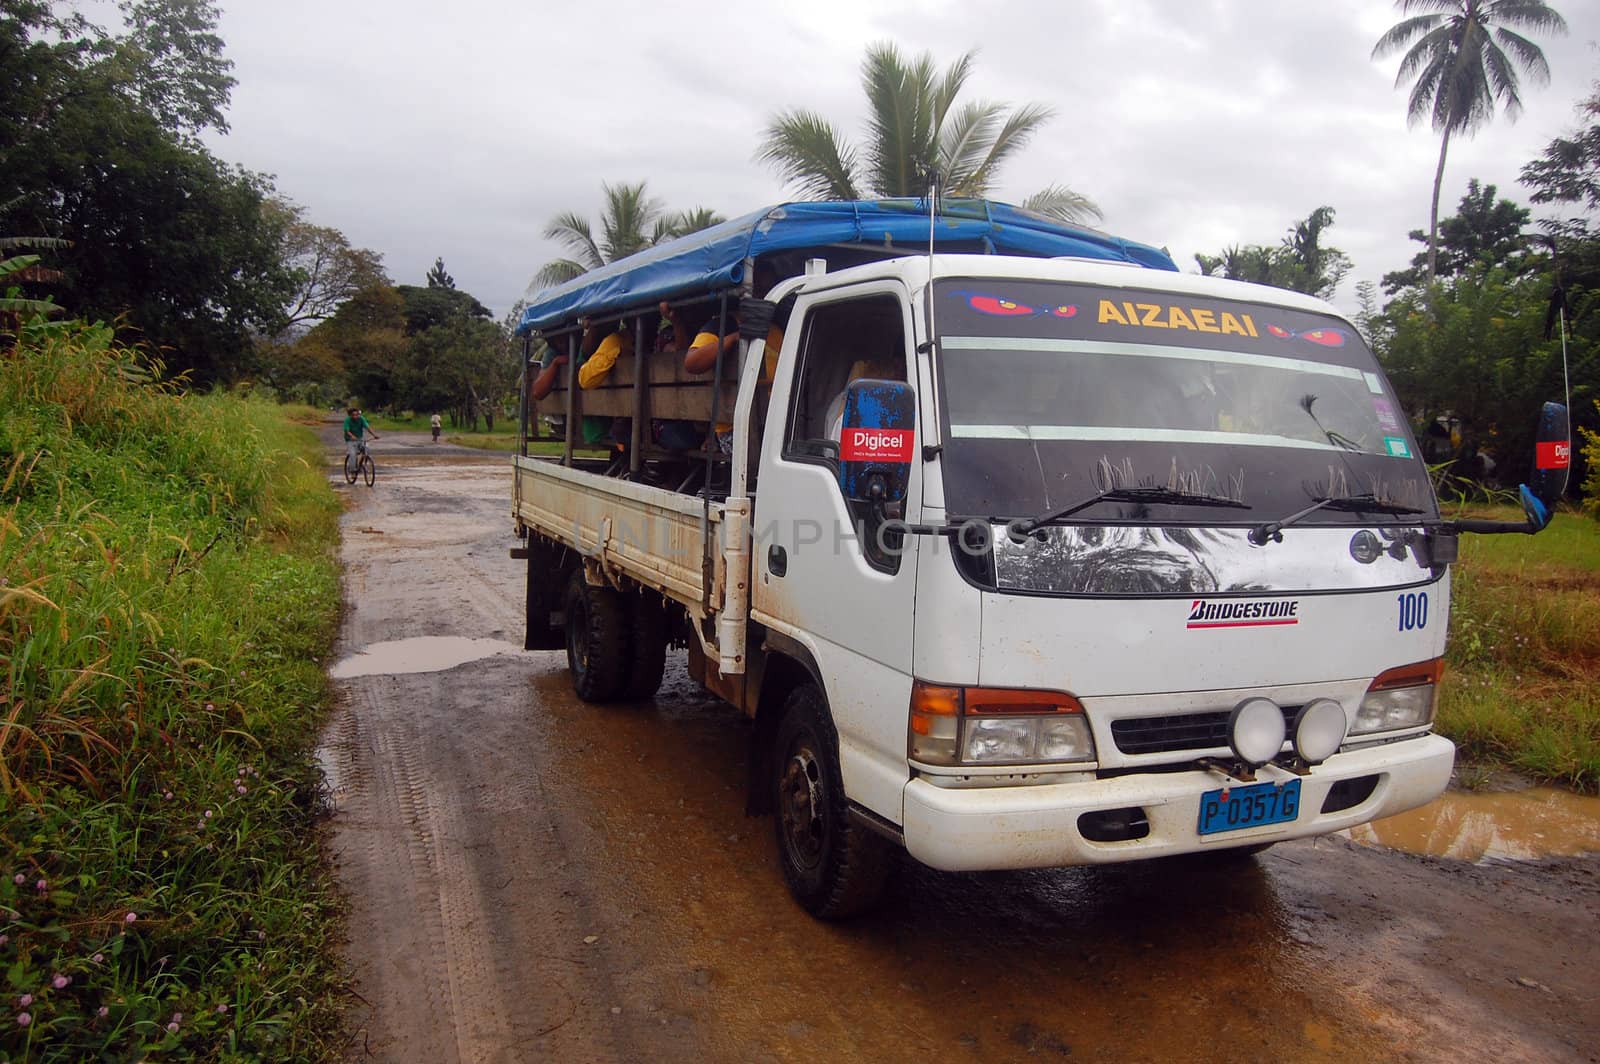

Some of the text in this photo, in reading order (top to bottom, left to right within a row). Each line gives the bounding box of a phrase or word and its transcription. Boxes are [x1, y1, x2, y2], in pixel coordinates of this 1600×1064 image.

[1098, 300, 1259, 337] AIZAEAI
[854, 432, 903, 450] Digicel
[1188, 600, 1299, 620] BRIDGESTONE
[1397, 592, 1428, 632] 100
